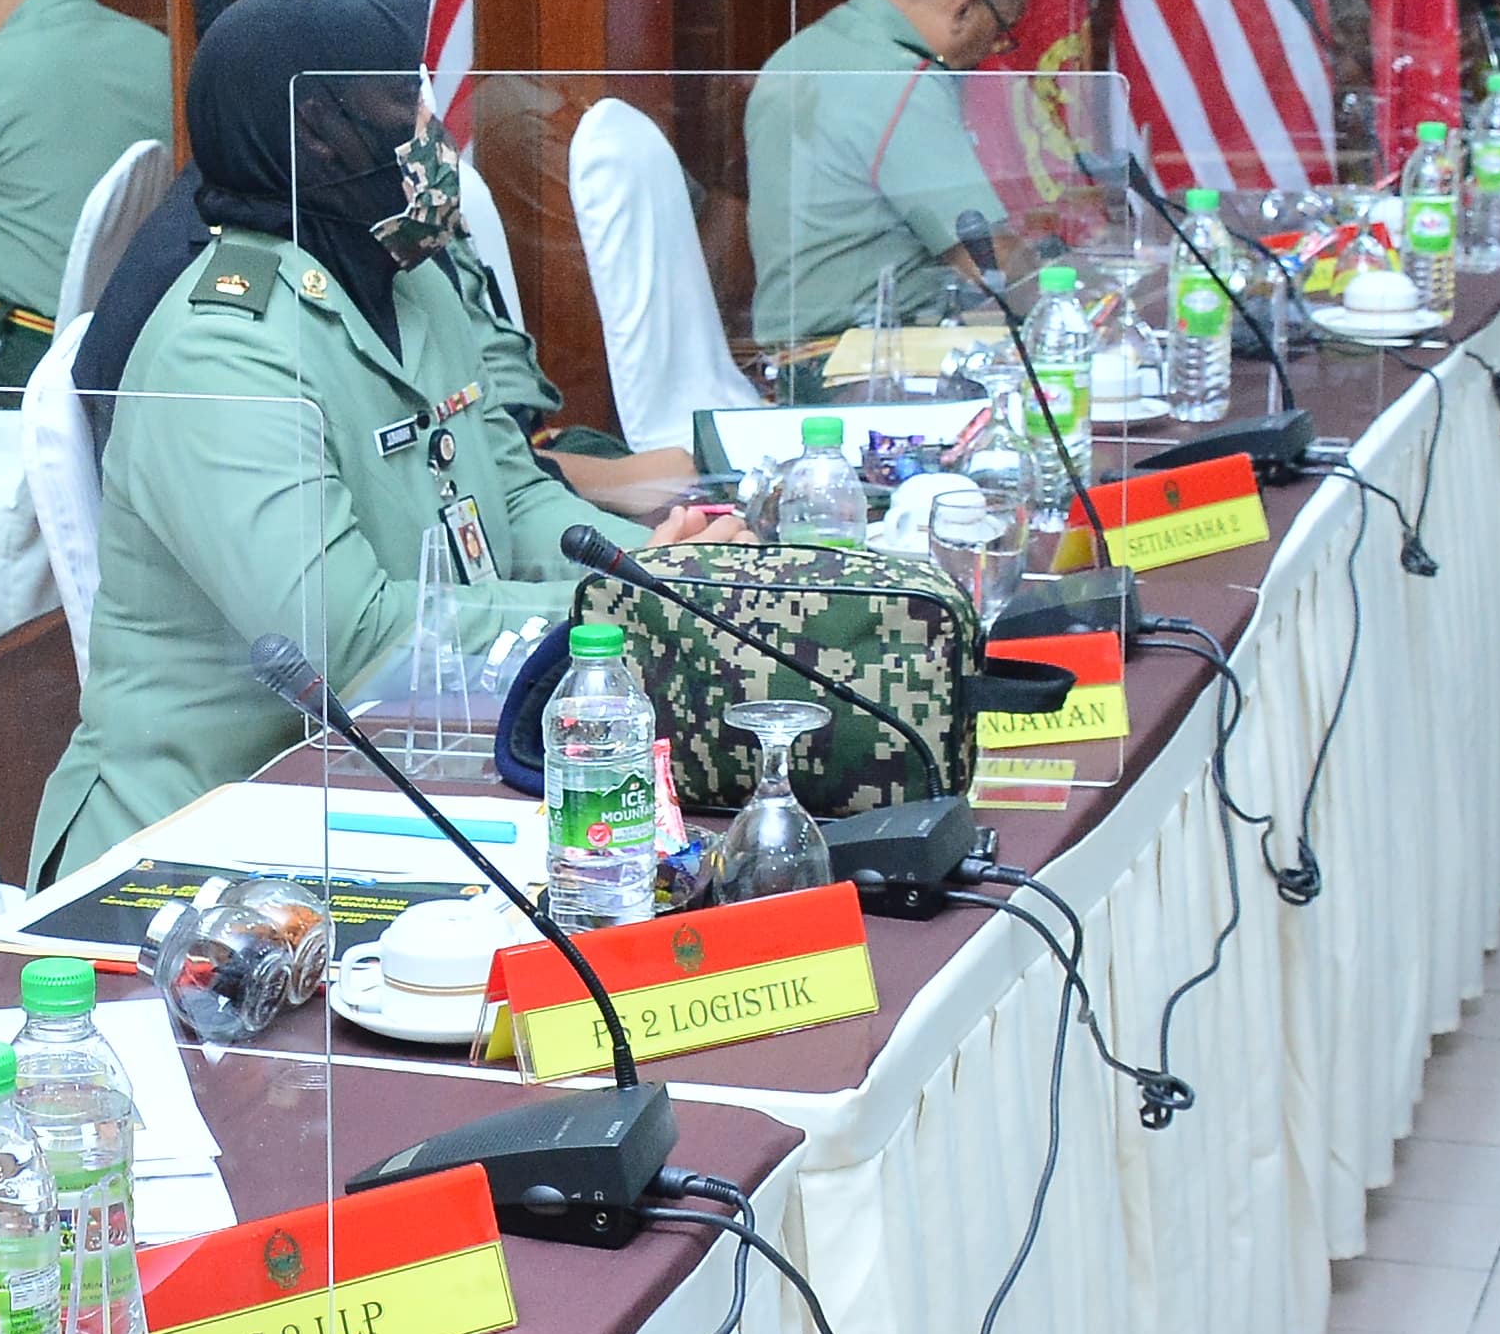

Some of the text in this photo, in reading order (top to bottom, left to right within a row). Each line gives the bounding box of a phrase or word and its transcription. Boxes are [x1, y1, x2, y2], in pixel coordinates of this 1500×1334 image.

[1128, 516, 1228, 558] SETIAUSAHA
[621, 789, 647, 808] ICE
[641, 1008, 662, 1039] 2
[668, 975, 817, 1034] LOGISTIK
